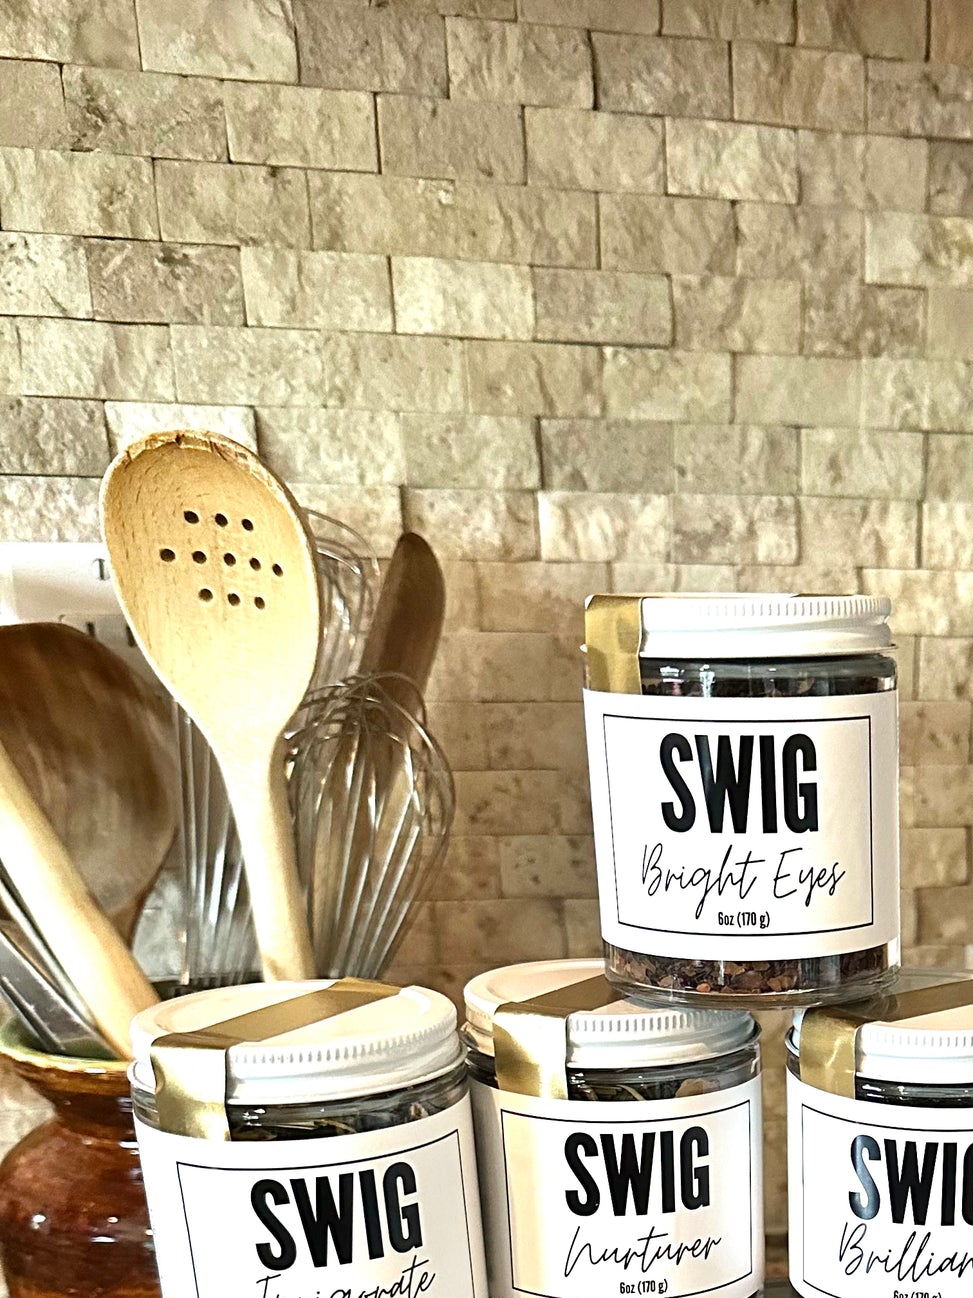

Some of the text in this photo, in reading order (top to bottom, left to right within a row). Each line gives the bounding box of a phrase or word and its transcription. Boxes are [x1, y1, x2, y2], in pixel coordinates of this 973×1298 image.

[660, 733, 818, 833] SWIG
[642, 843, 845, 919] Bright Eyes
[718, 911, 770, 929] 6oz (170 g)
[564, 1126, 710, 1216] SWIG
[250, 1161, 423, 1271] SWIG
[564, 1226, 721, 1277] Nurturer
[620, 1279, 667, 1295] 6oz (170 g)
